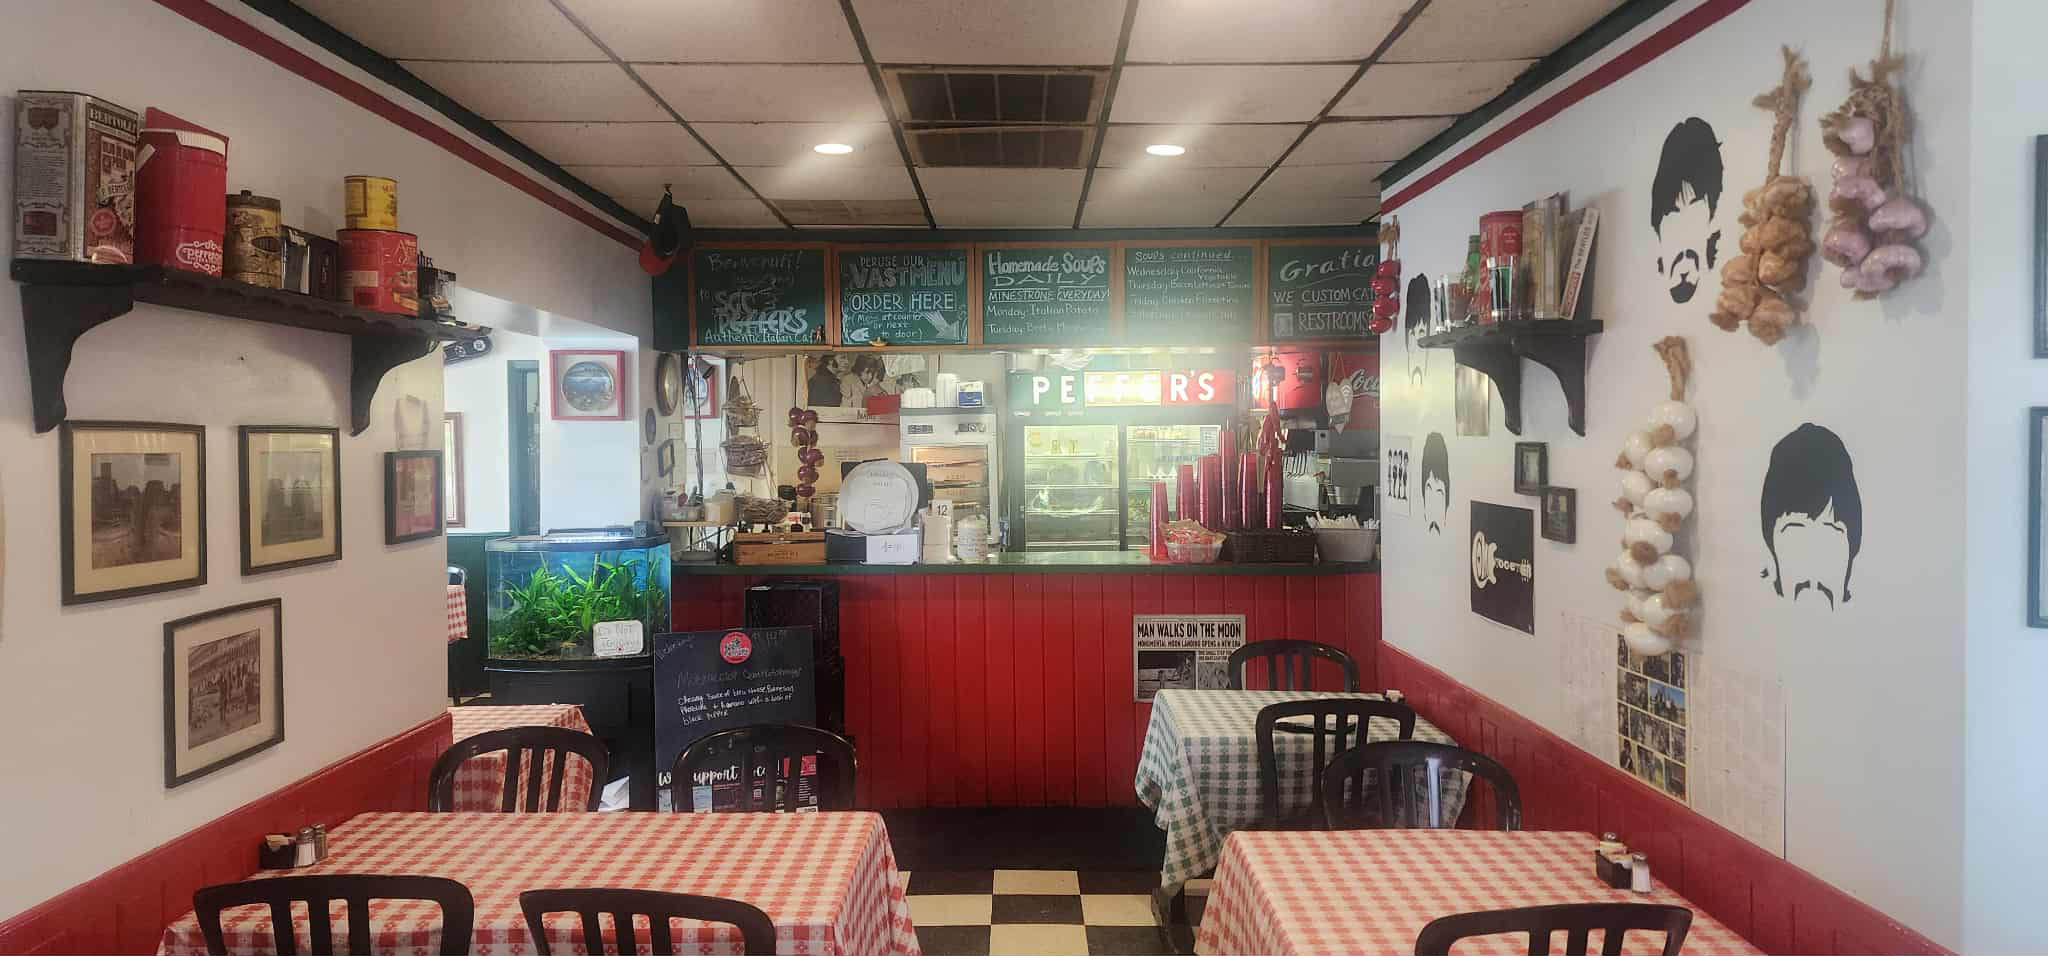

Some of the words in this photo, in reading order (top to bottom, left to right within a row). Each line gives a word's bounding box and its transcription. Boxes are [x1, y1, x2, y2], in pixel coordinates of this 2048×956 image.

[988, 252, 1059, 275] Homemade
[848, 264, 909, 289] VAST
[992, 273, 1097, 287] DAILY
[851, 294, 905, 311] ORDER
[911, 293, 955, 310] HERE
[988, 290, 1057, 301] MINESTRONE
[1272, 290, 1296, 303] WE
[1302, 287, 1351, 303] CUSTOM
[705, 328, 751, 344] Authentic
[1137, 623, 1155, 637] MAN
[1157, 623, 1185, 637] WALKS
[1186, 623, 1198, 637] ON
[1200, 623, 1215, 637] THE
[1218, 623, 1241, 637] MOON
[693, 765, 740, 785] upport
